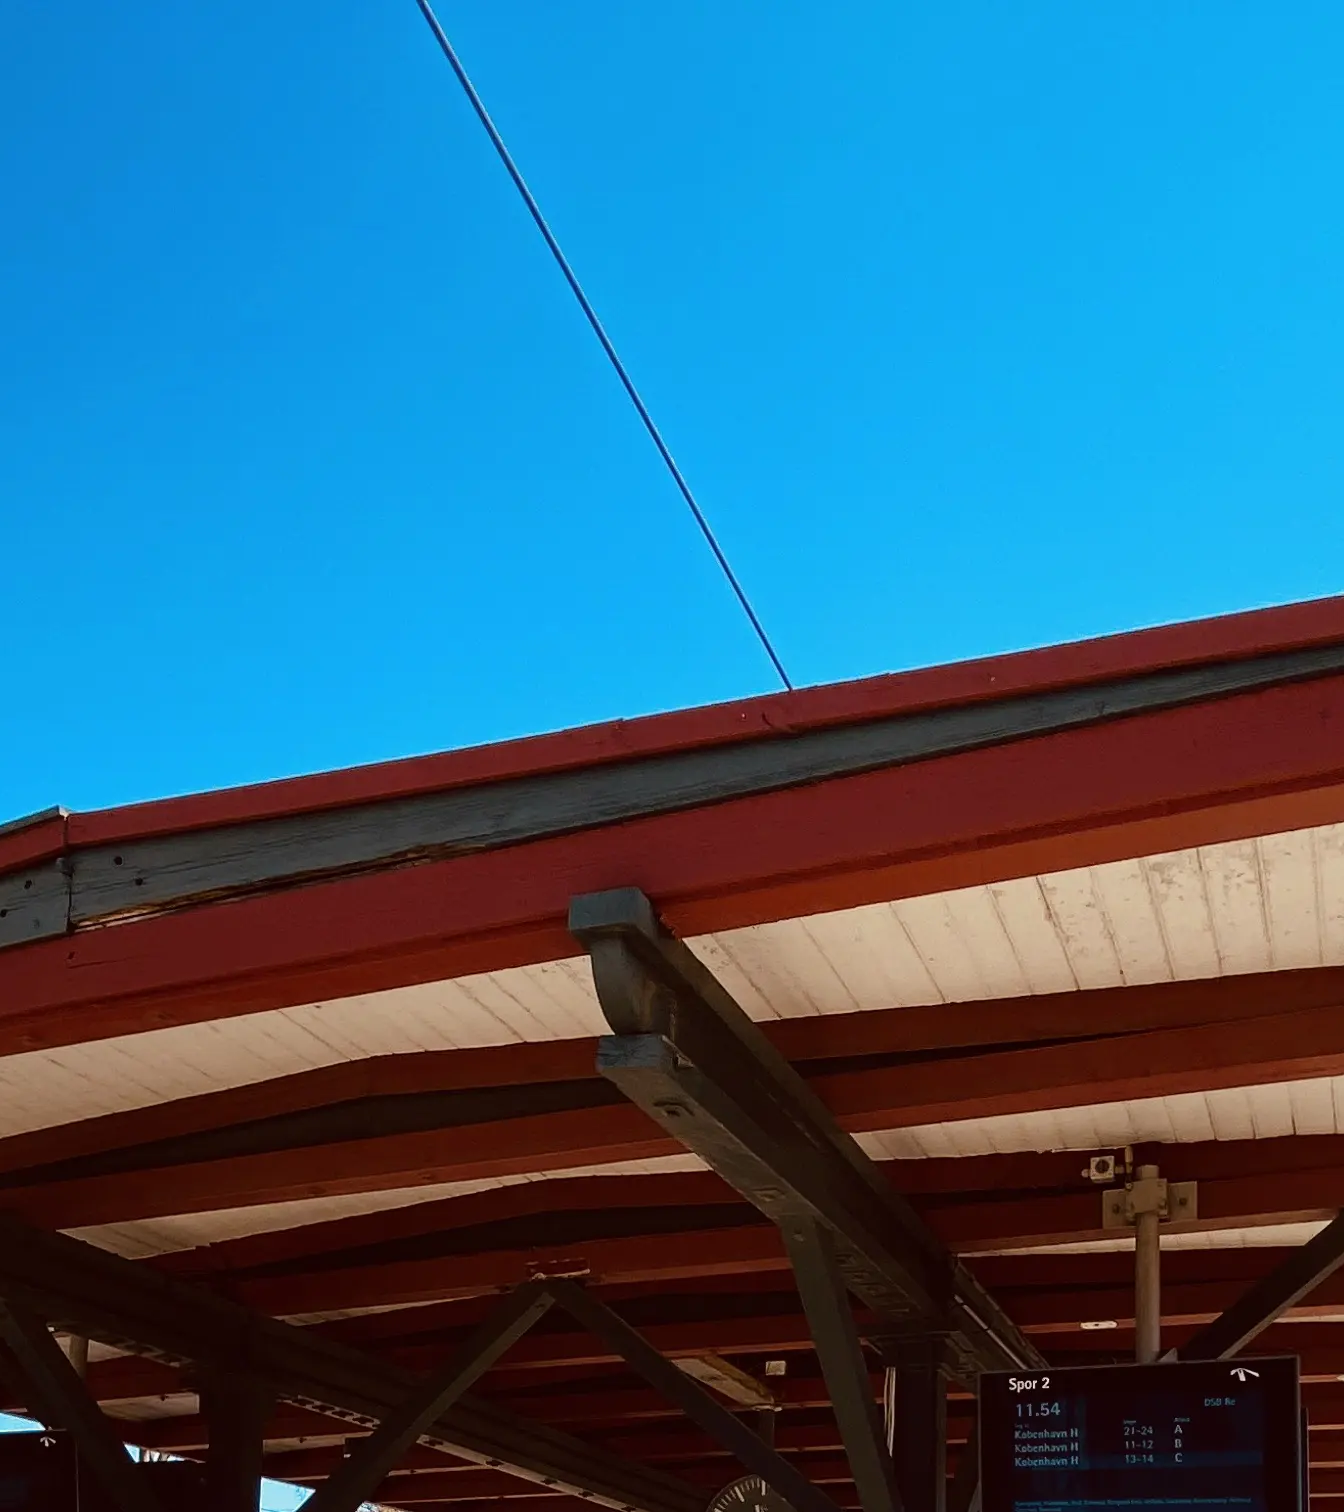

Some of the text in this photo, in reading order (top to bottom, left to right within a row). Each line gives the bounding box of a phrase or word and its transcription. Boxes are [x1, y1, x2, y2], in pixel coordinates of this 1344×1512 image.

[1008, 1376, 1050, 1393] Spor 2
[1016, 1402, 1061, 1417] 11.54
[1174, 1424, 1183, 1434] A
[1174, 1438, 1182, 1449] B
[1174, 1453, 1183, 1463] C
